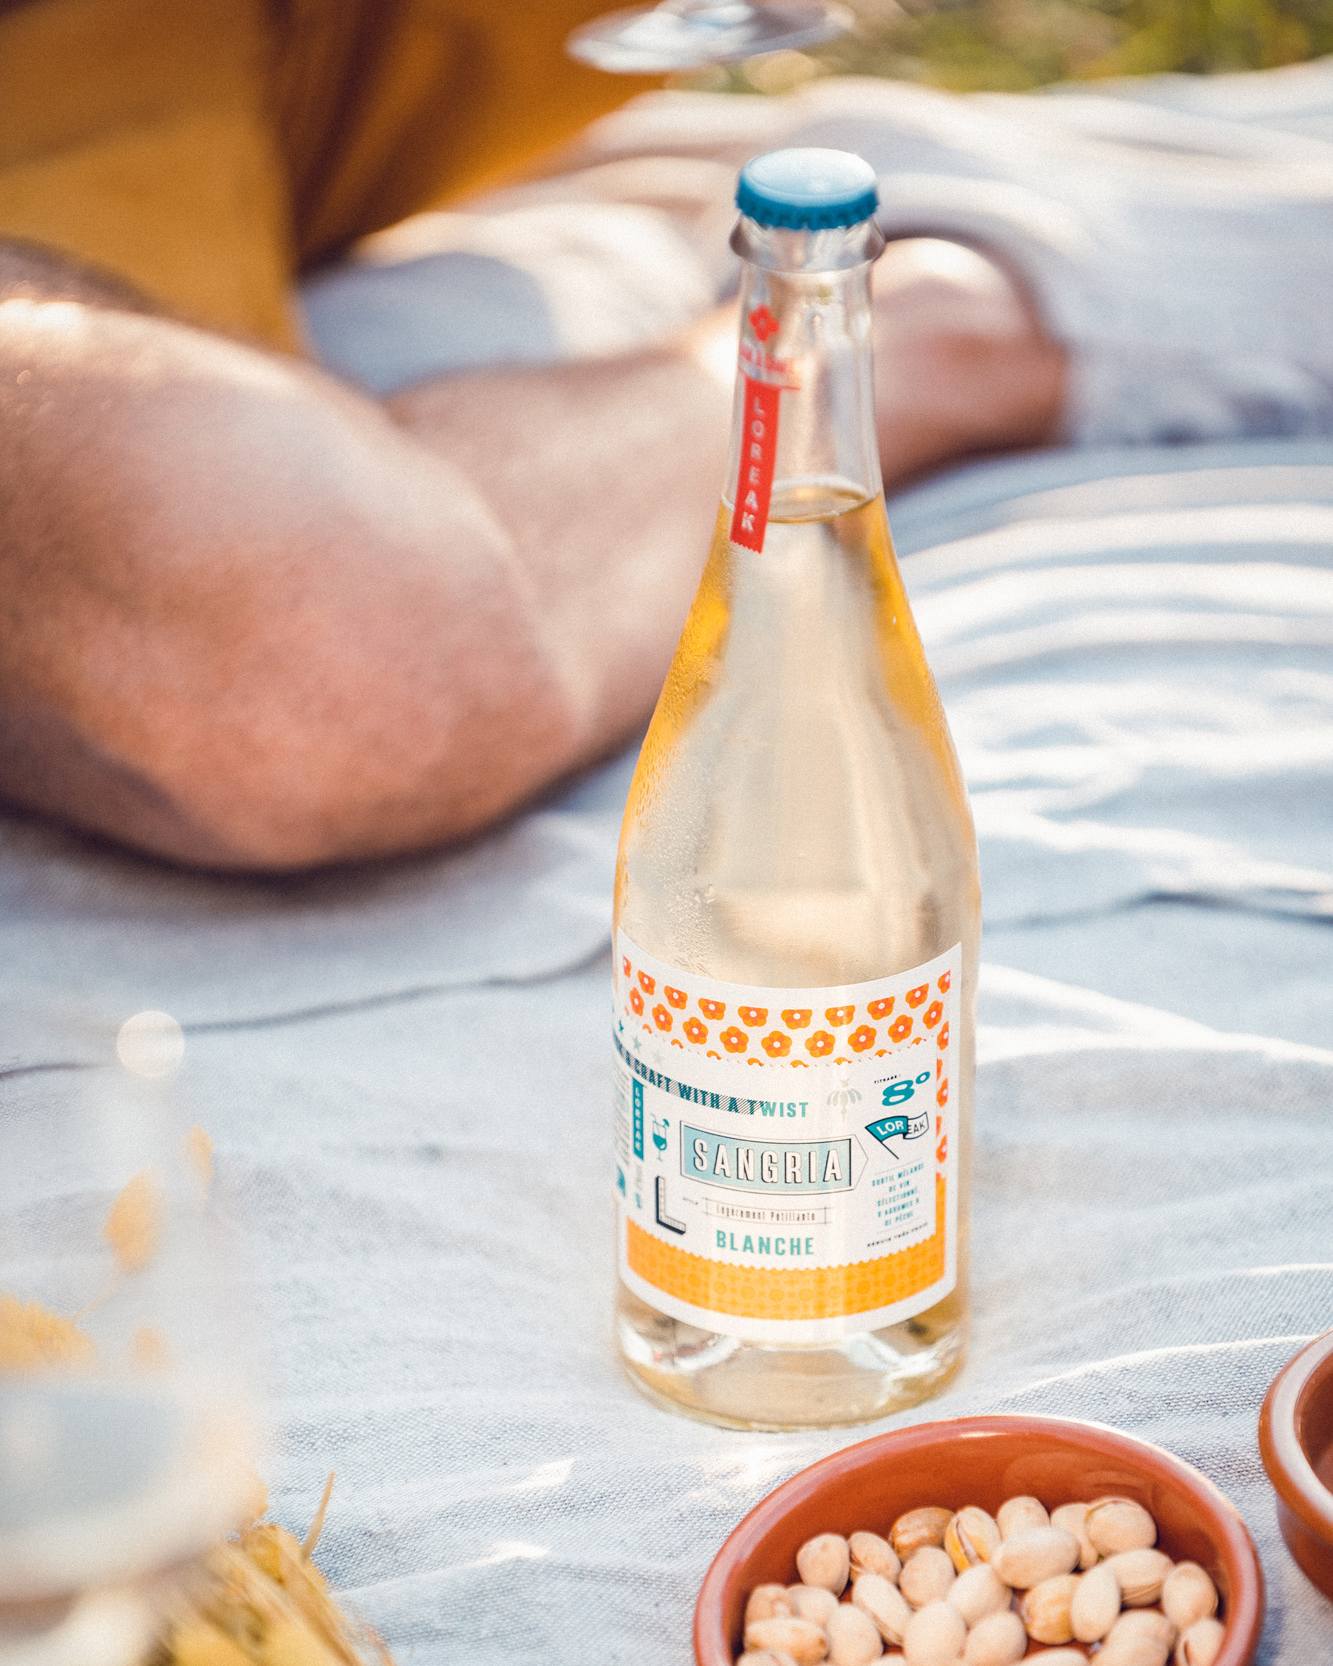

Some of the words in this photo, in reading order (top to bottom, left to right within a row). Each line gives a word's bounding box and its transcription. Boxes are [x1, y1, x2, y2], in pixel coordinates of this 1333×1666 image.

[741, 396, 765, 532] LOREAK
[633, 1058, 672, 1092] CRAFT
[677, 1081, 721, 1110] WITH
[728, 1097, 740, 1114] A
[747, 1099, 809, 1118] TWIST
[693, 1138, 843, 1184] SANGRIA
[716, 1230, 815, 1256] BLANCHE
